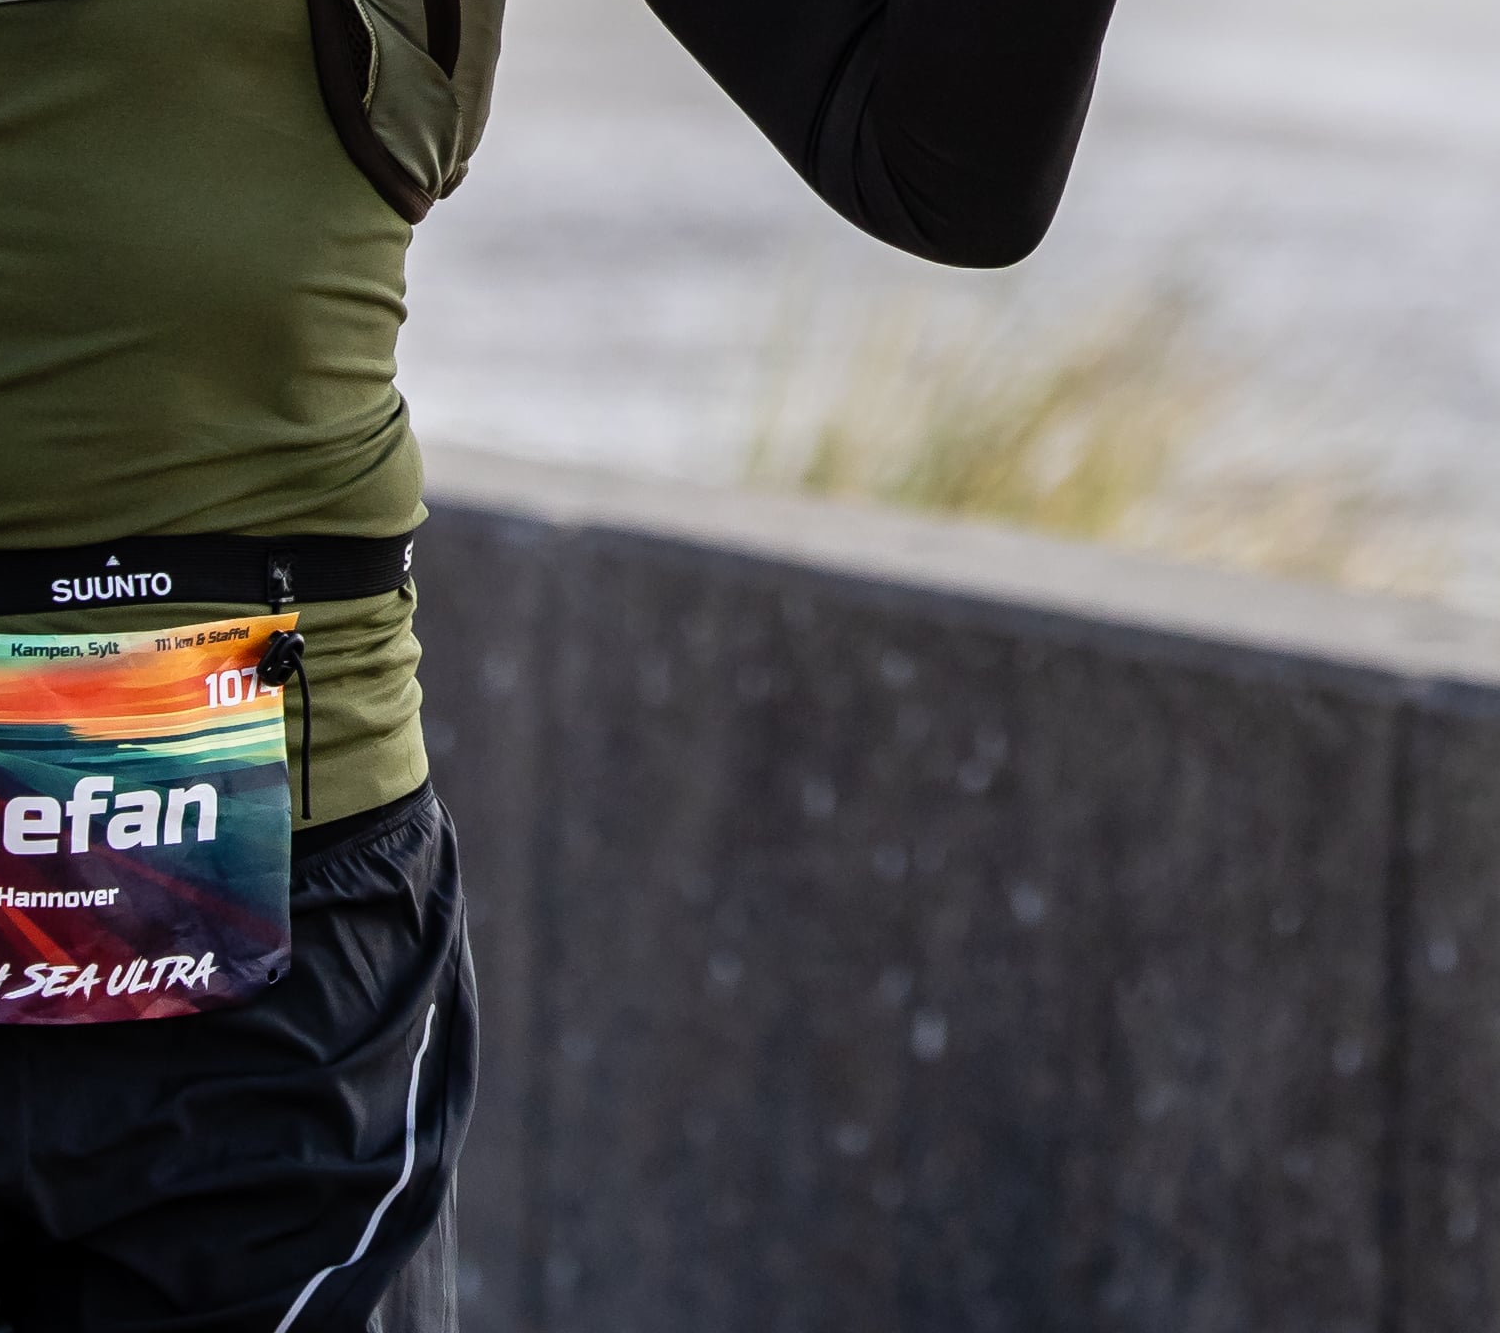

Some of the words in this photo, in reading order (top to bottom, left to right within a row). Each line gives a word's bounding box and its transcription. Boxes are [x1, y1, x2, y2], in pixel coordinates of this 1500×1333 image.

[51, 572, 172, 602] SUUNTO
[11, 642, 84, 660] Kampen,
[88, 641, 120, 658] Sylt
[155, 637, 171, 651] 111
[175, 636, 193, 650] km
[196, 633, 206, 646] &
[208, 626, 250, 644] Staffel
[1, 962, 104, 1001] SEA
[106, 950, 221, 996] ULTRA
